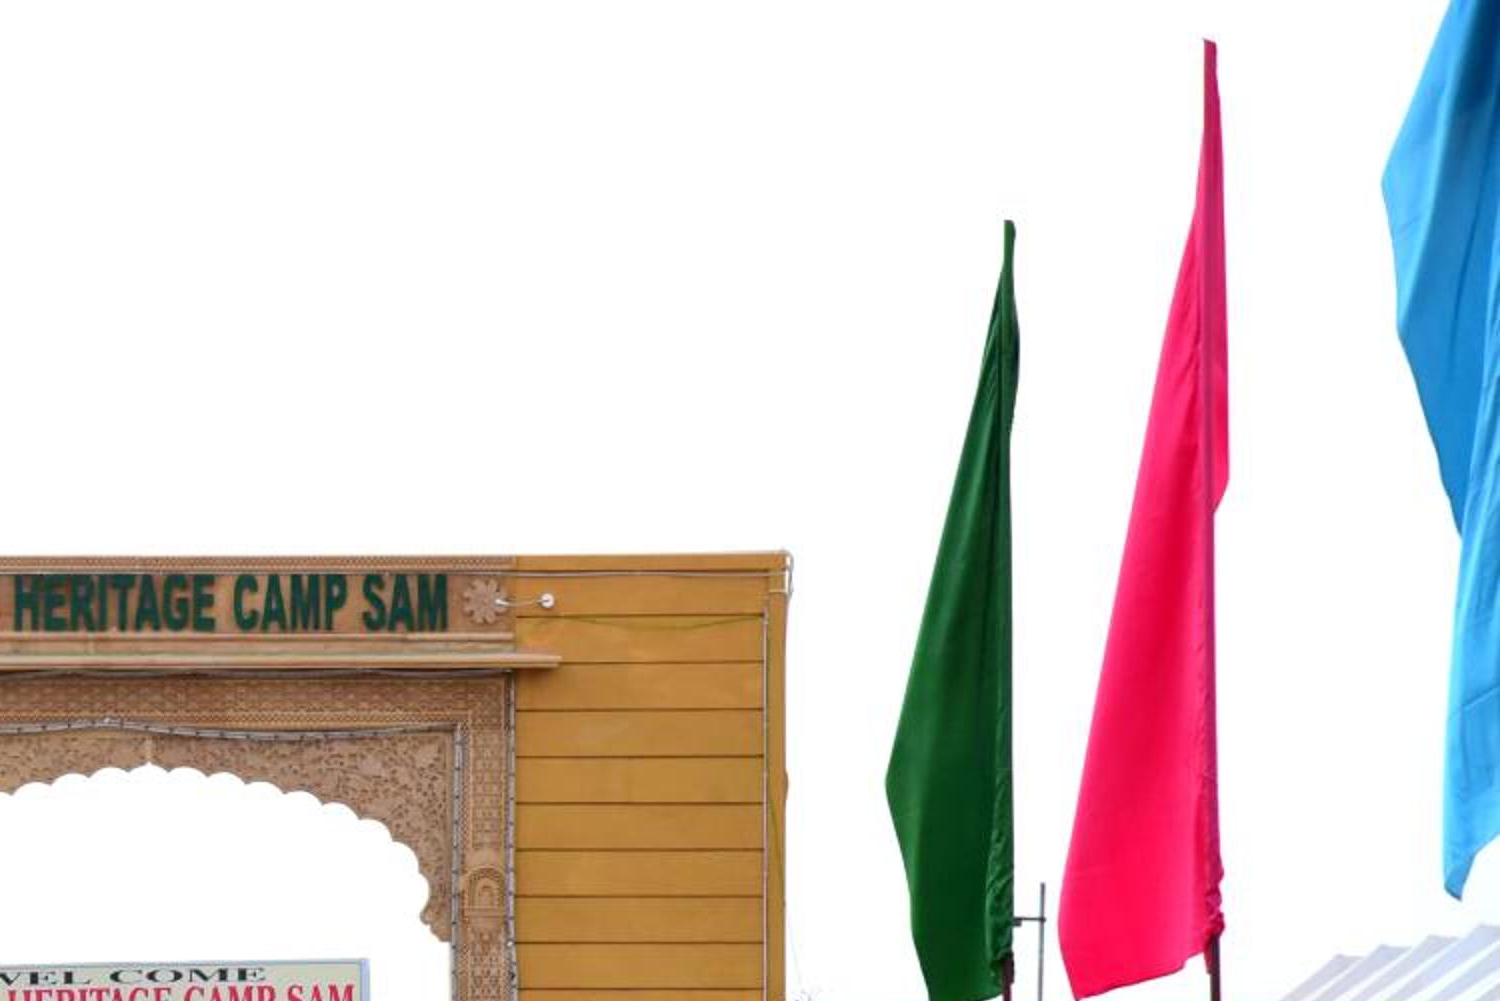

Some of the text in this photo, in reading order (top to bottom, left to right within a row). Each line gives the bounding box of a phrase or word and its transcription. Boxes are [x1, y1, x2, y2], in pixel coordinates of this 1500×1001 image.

[14, 574, 217, 631] HERITAGE
[233, 574, 348, 631] CAMP
[363, 574, 449, 631] SAM
[109, 967, 266, 984] COME
